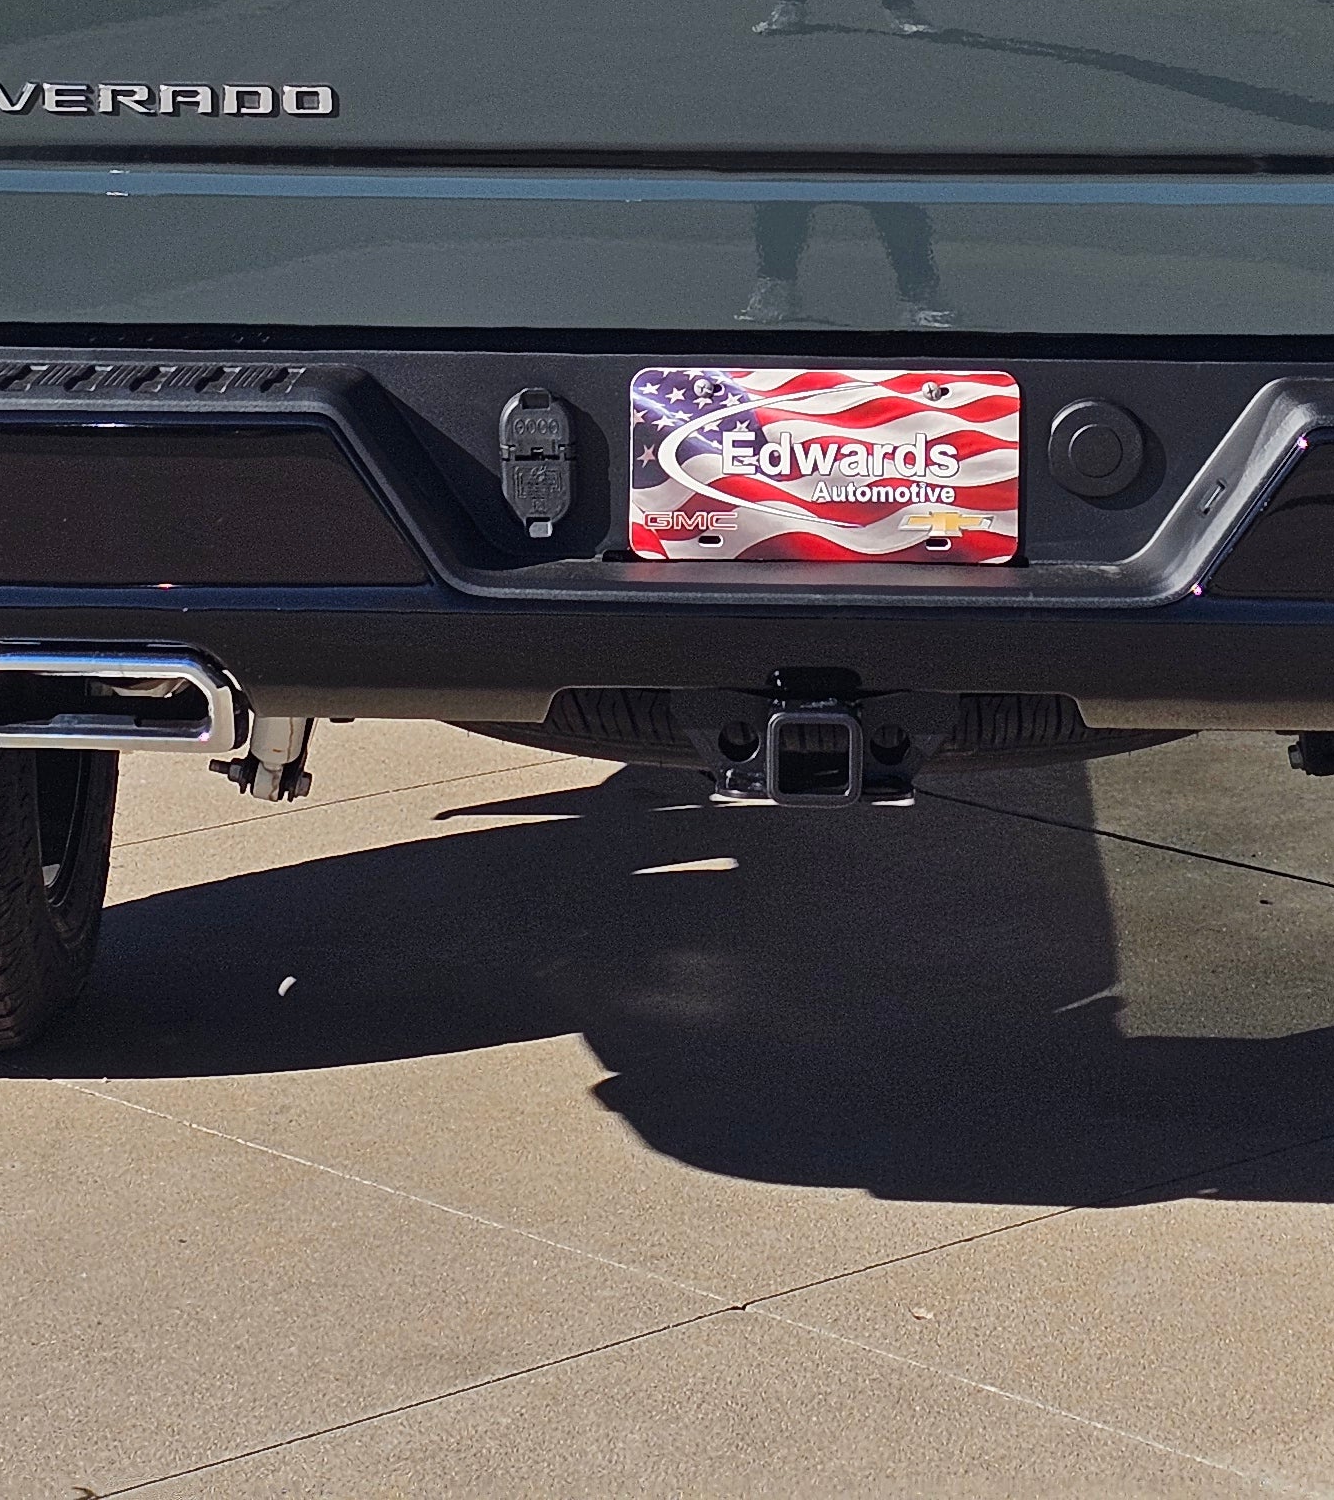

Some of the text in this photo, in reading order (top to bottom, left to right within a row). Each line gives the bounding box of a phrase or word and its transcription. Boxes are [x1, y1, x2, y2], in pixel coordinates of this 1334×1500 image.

[721, 431, 960, 479] Edwards
[811, 481, 956, 504] Automotive
[642, 512, 739, 531] GMC
